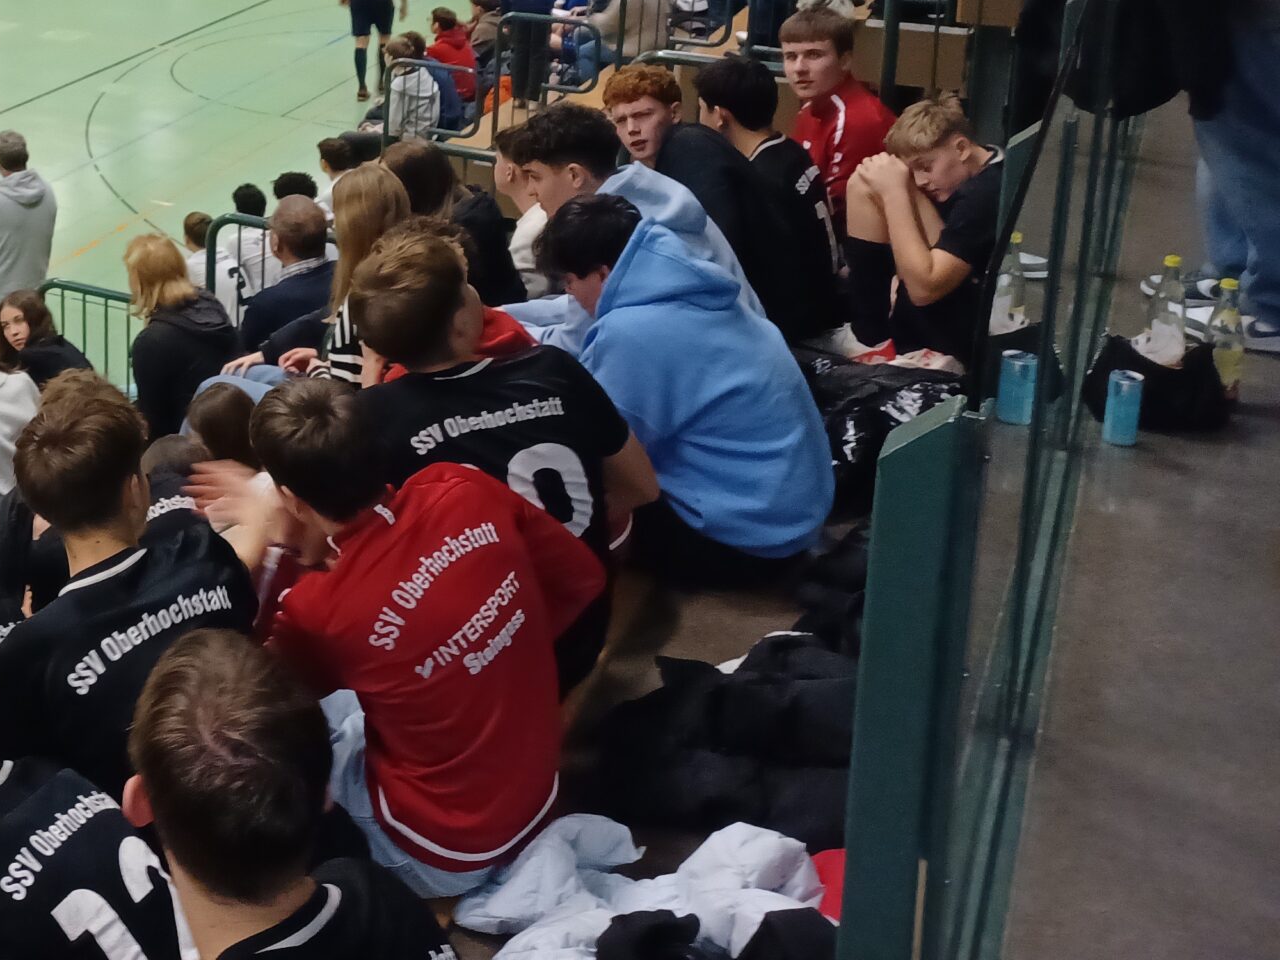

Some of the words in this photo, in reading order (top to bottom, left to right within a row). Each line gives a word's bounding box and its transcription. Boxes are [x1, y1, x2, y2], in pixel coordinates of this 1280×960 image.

[410, 423, 444, 455] SSV
[443, 396, 565, 438] Oberhochstatt
[368, 606, 406, 651] SSV
[391, 522, 500, 610] Oberhochstatt
[432, 570, 520, 667] INTERSPORT
[67, 649, 107, 695] SSV
[100, 585, 233, 662] Oberhochstatt
[0, 846, 43, 901] SSV
